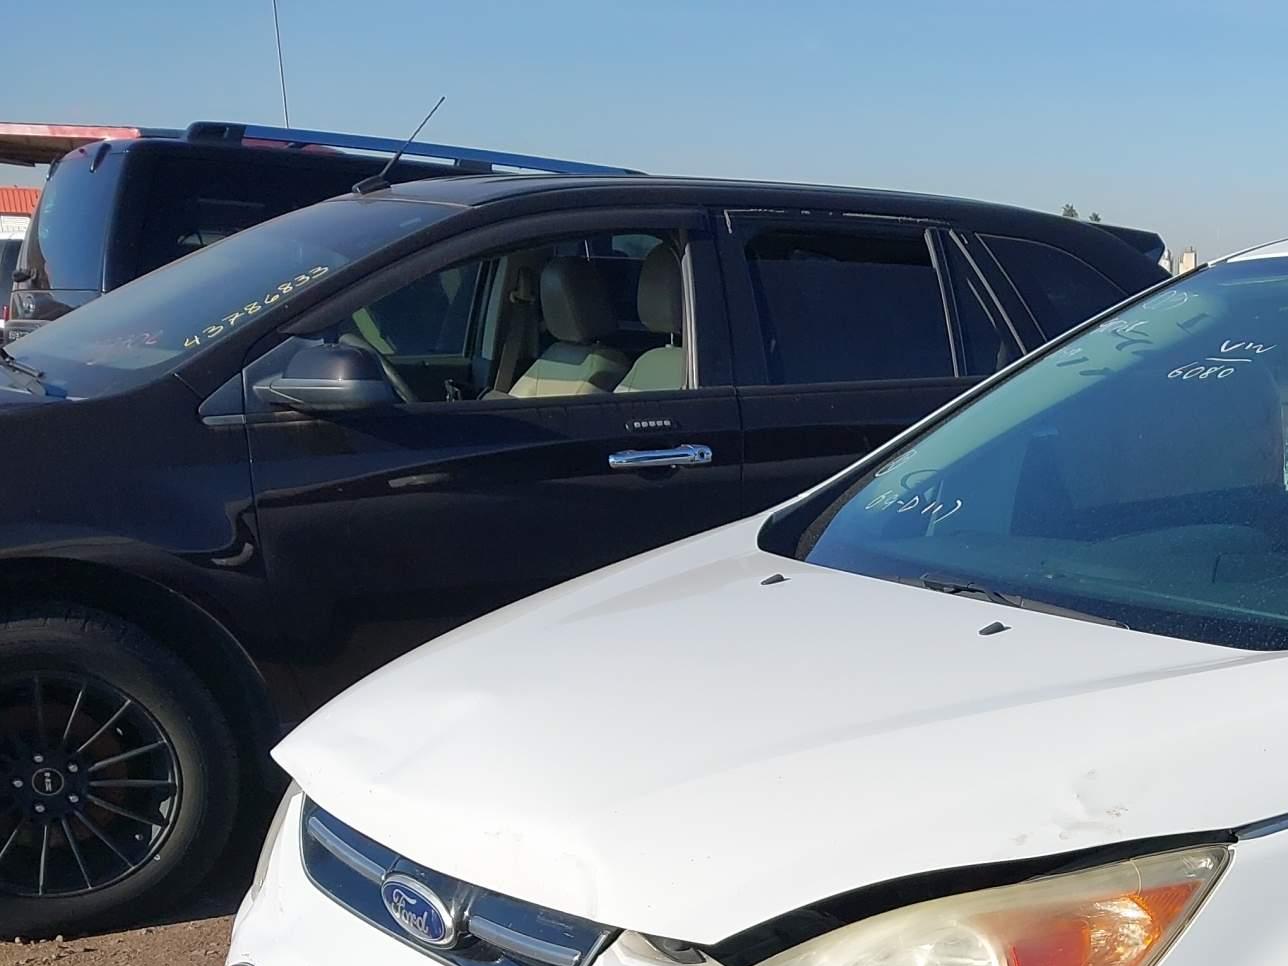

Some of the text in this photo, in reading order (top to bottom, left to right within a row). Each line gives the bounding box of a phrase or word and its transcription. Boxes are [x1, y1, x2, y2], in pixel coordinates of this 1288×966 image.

[184, 265, 329, 347] 43786833
[1167, 361, 1235, 379] 6080
[391, 888, 430, 935] Ford
